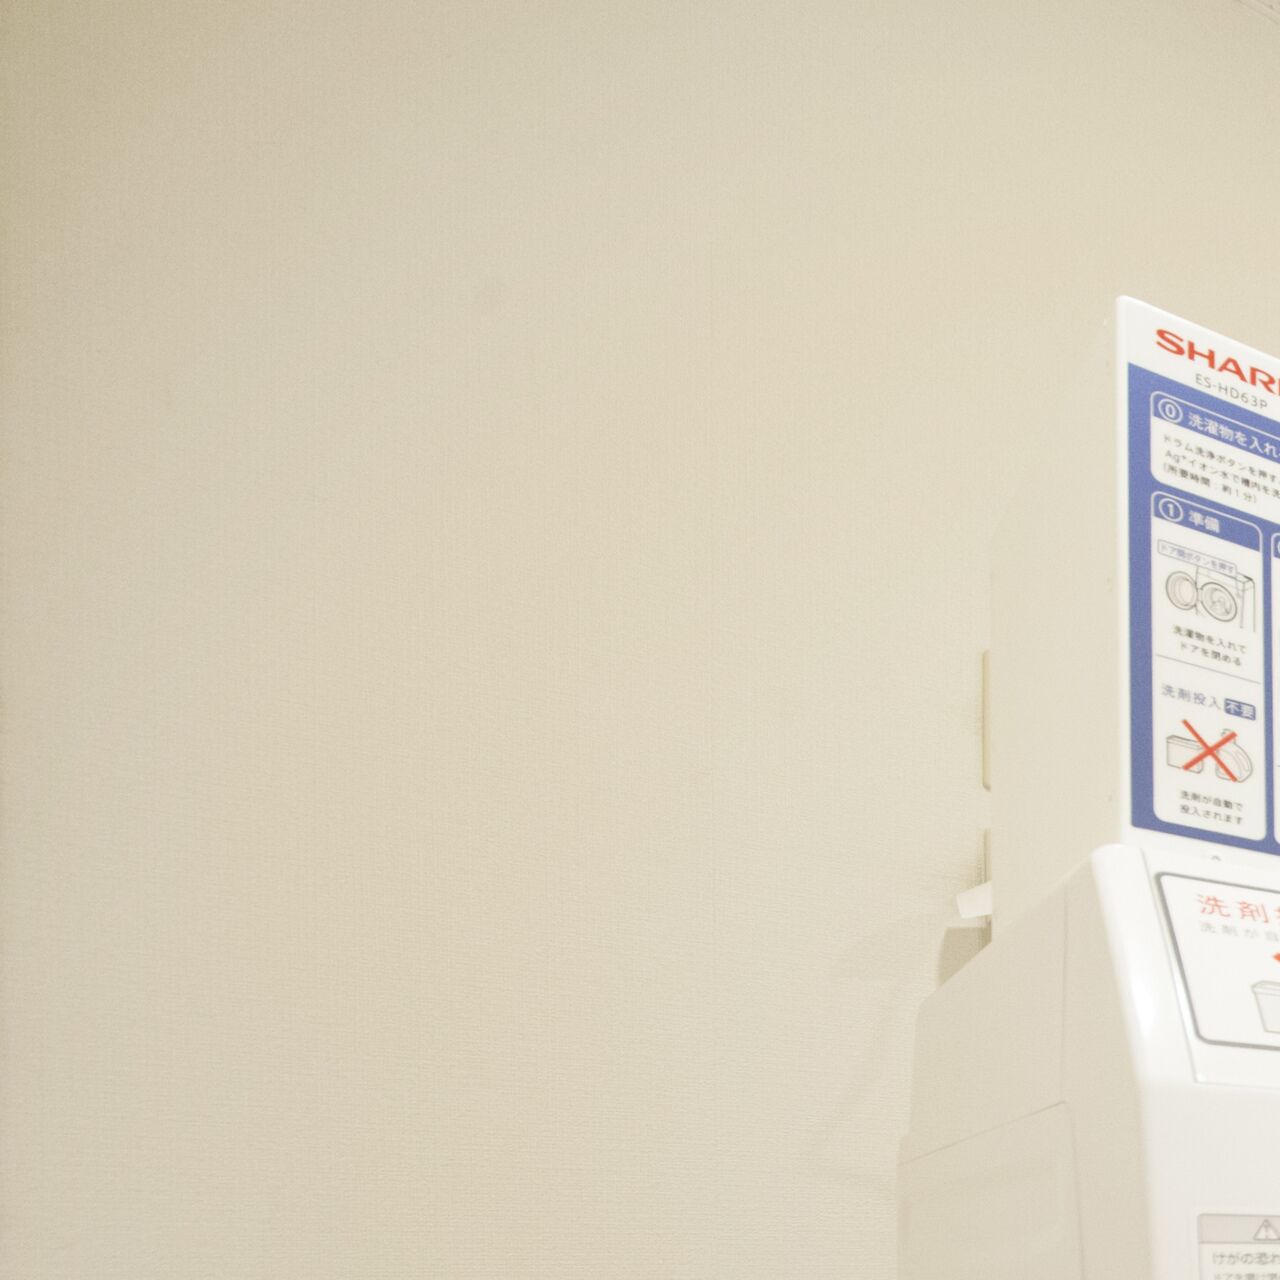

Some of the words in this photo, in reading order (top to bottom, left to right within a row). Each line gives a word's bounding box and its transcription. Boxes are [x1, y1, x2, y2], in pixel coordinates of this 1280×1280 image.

[1195, 373, 1269, 410] ES-HD63P
[1188, 507, 1221, 535] 準備
[1179, 639, 1242, 668] ドアを閉める
[1159, 681, 1222, 712] 洗剤投入
